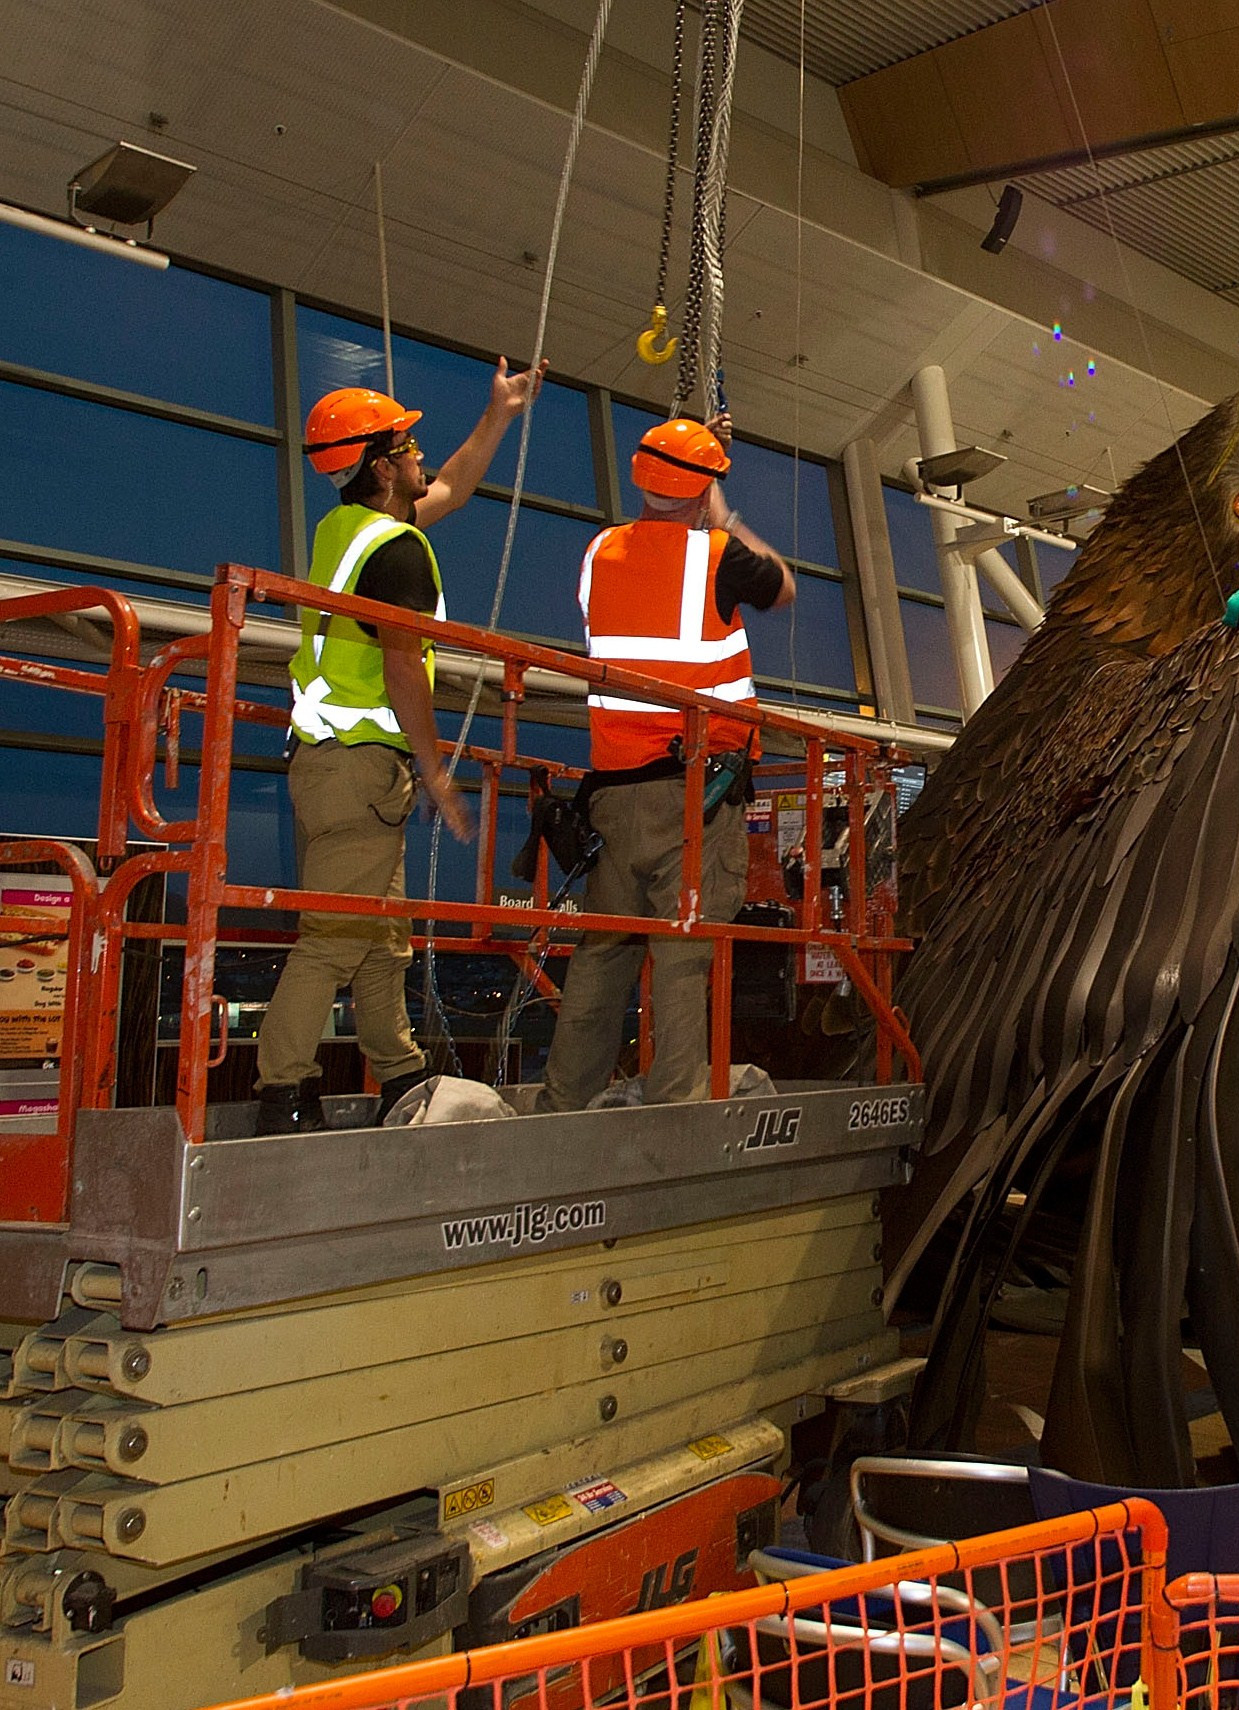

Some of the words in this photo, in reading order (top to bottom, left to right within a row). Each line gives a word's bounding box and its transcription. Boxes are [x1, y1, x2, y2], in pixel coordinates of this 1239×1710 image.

[34, 893, 62, 905] Design
[500, 895, 536, 909] Board
[557, 899, 578, 913] alls
[745, 1108, 802, 1150] JLG
[849, 1097, 909, 1130] 2646ES
[442, 1201, 606, 1249] www.jlg.com
[620, 1547, 700, 1613] JLG
